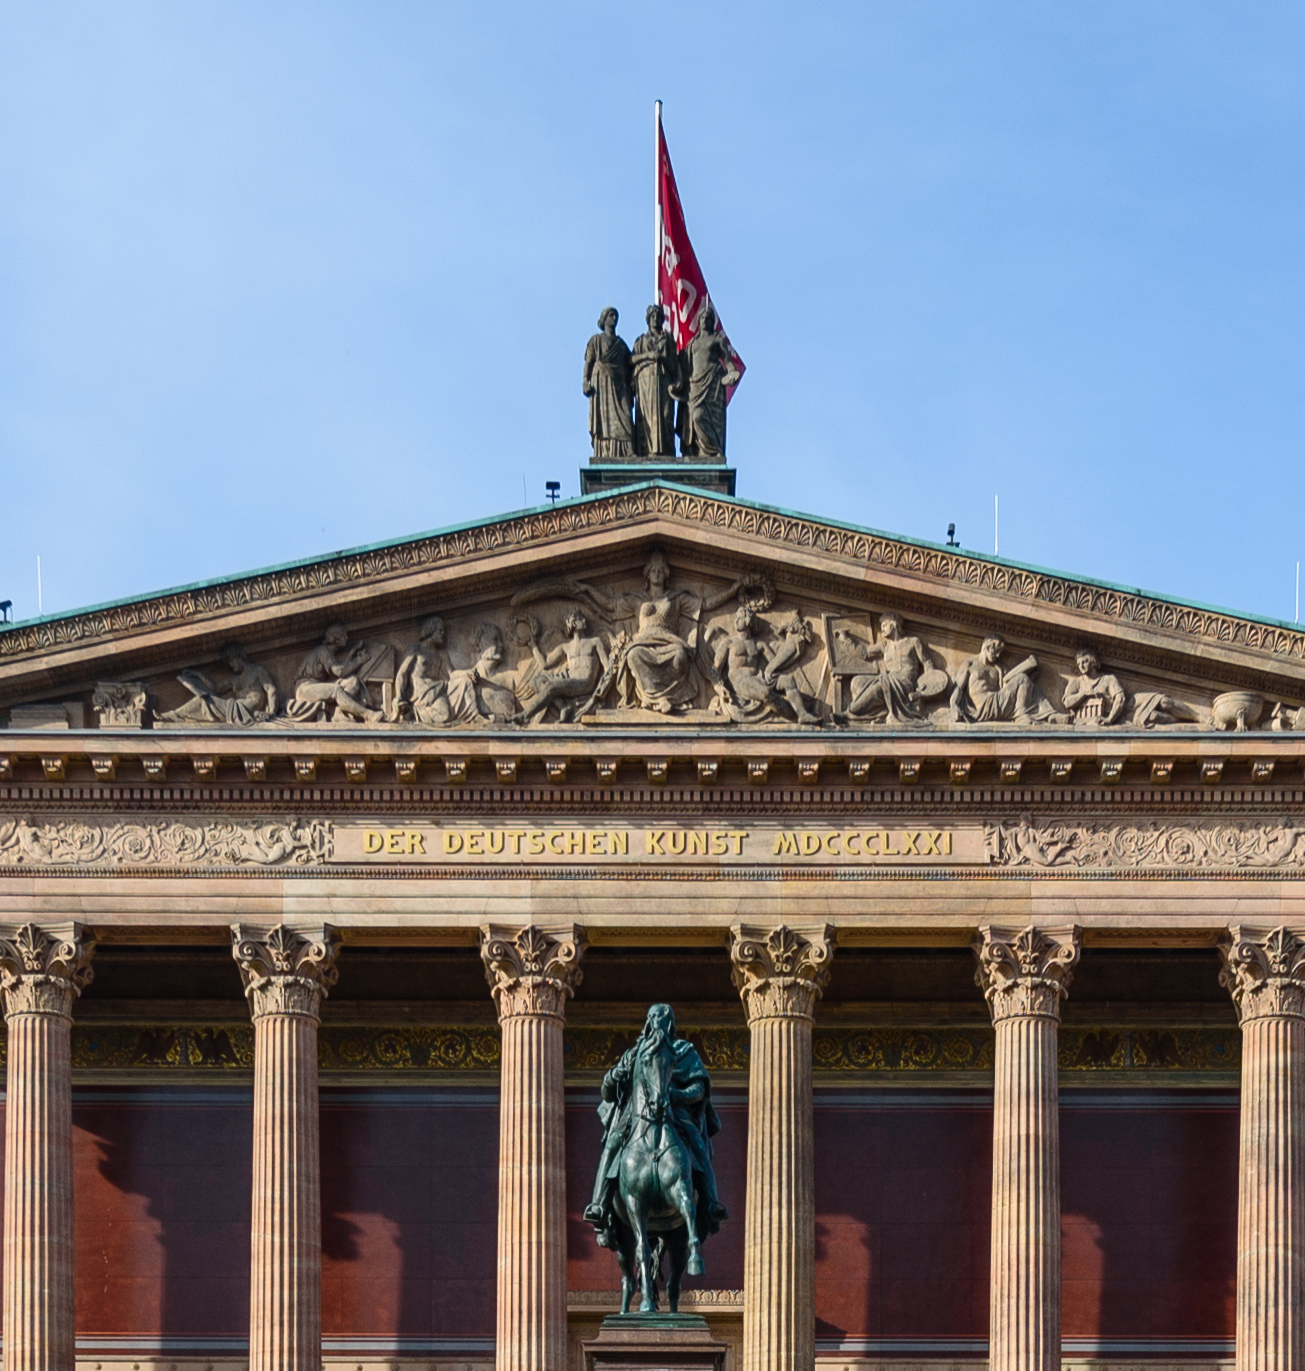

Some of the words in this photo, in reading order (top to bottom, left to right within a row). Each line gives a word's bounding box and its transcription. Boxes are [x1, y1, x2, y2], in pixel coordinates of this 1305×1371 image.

[363, 830, 426, 854] DER
[444, 830, 629, 855] DEUTSCHEN
[646, 830, 749, 855] KUNST
[773, 831, 953, 856] MDCCCLXXI
